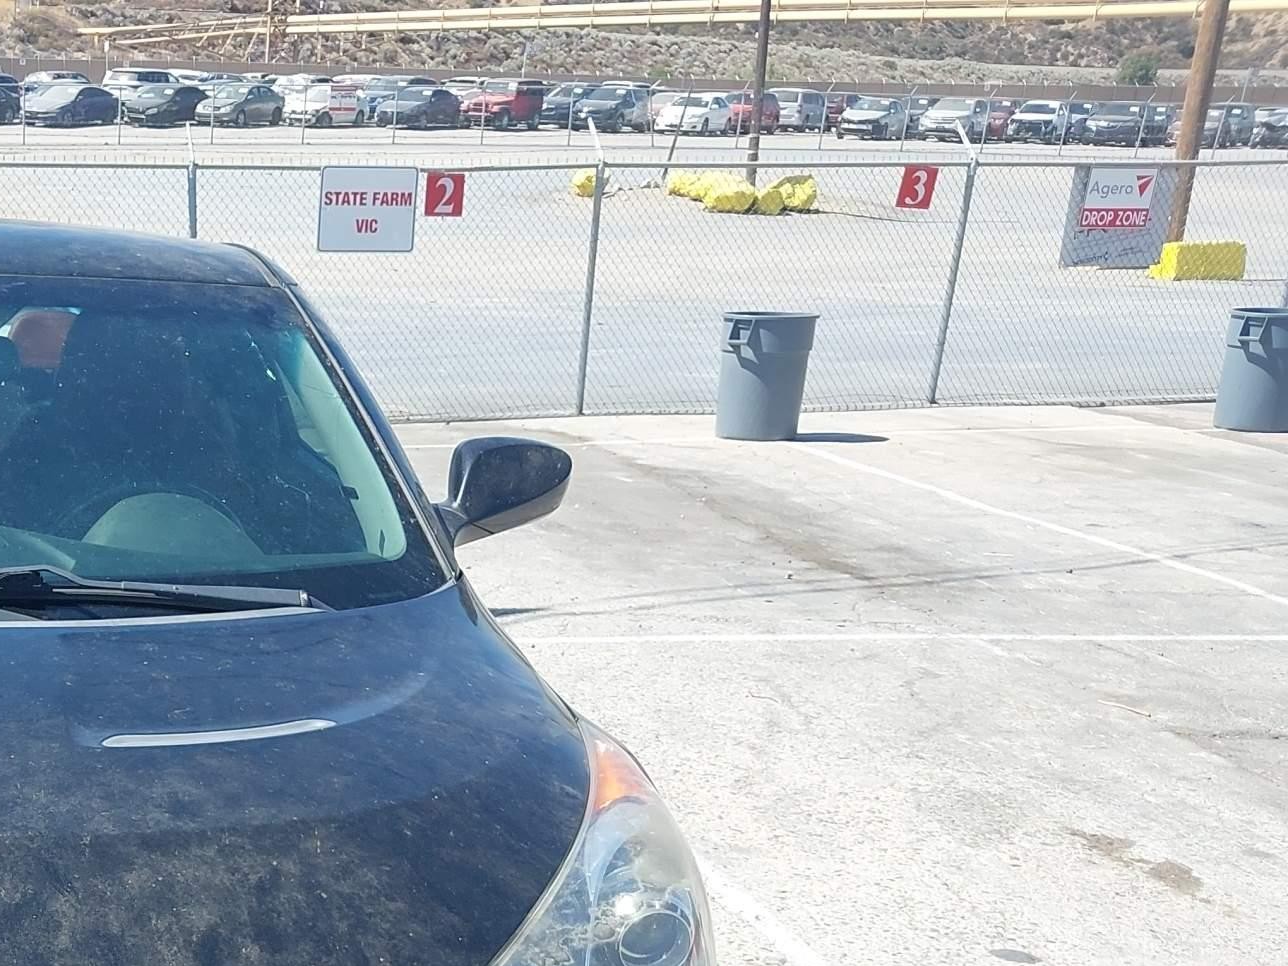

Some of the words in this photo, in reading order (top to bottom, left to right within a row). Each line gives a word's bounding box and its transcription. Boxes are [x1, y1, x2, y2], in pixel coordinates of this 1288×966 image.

[904, 169, 928, 205] 3
[1089, 181, 1133, 198] Agero
[324, 191, 367, 206] STATE
[372, 191, 412, 207] FARM
[433, 177, 455, 214] 2
[356, 218, 378, 233] VIC
[1082, 210, 1114, 226] DROP
[1116, 210, 1147, 226] ZONE
